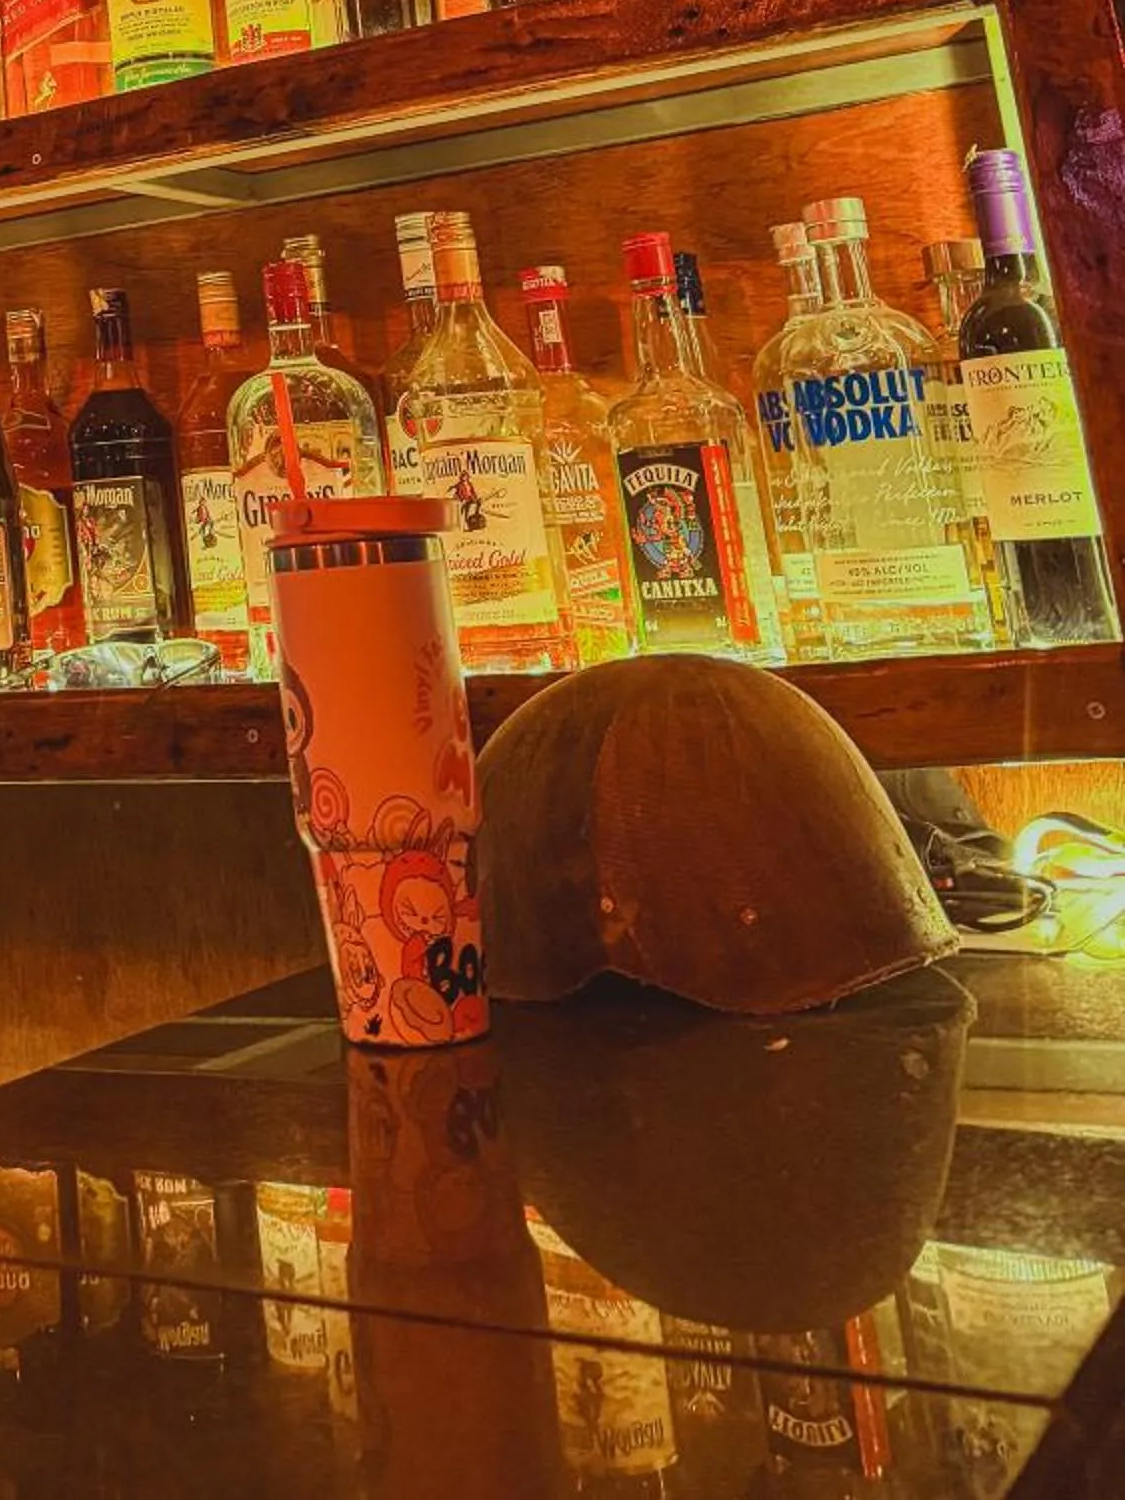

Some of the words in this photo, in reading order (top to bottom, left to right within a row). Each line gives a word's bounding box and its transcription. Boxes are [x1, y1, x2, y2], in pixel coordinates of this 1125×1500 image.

[793, 368, 926, 416] ABSOLUT
[805, 405, 923, 447] VODKA
[466, 449, 526, 479] Morgan
[627, 467, 694, 492] TEQUILA
[86, 483, 135, 508] Morgan
[1010, 491, 1084, 506] MERLOT
[641, 577, 719, 600] CANITXA
